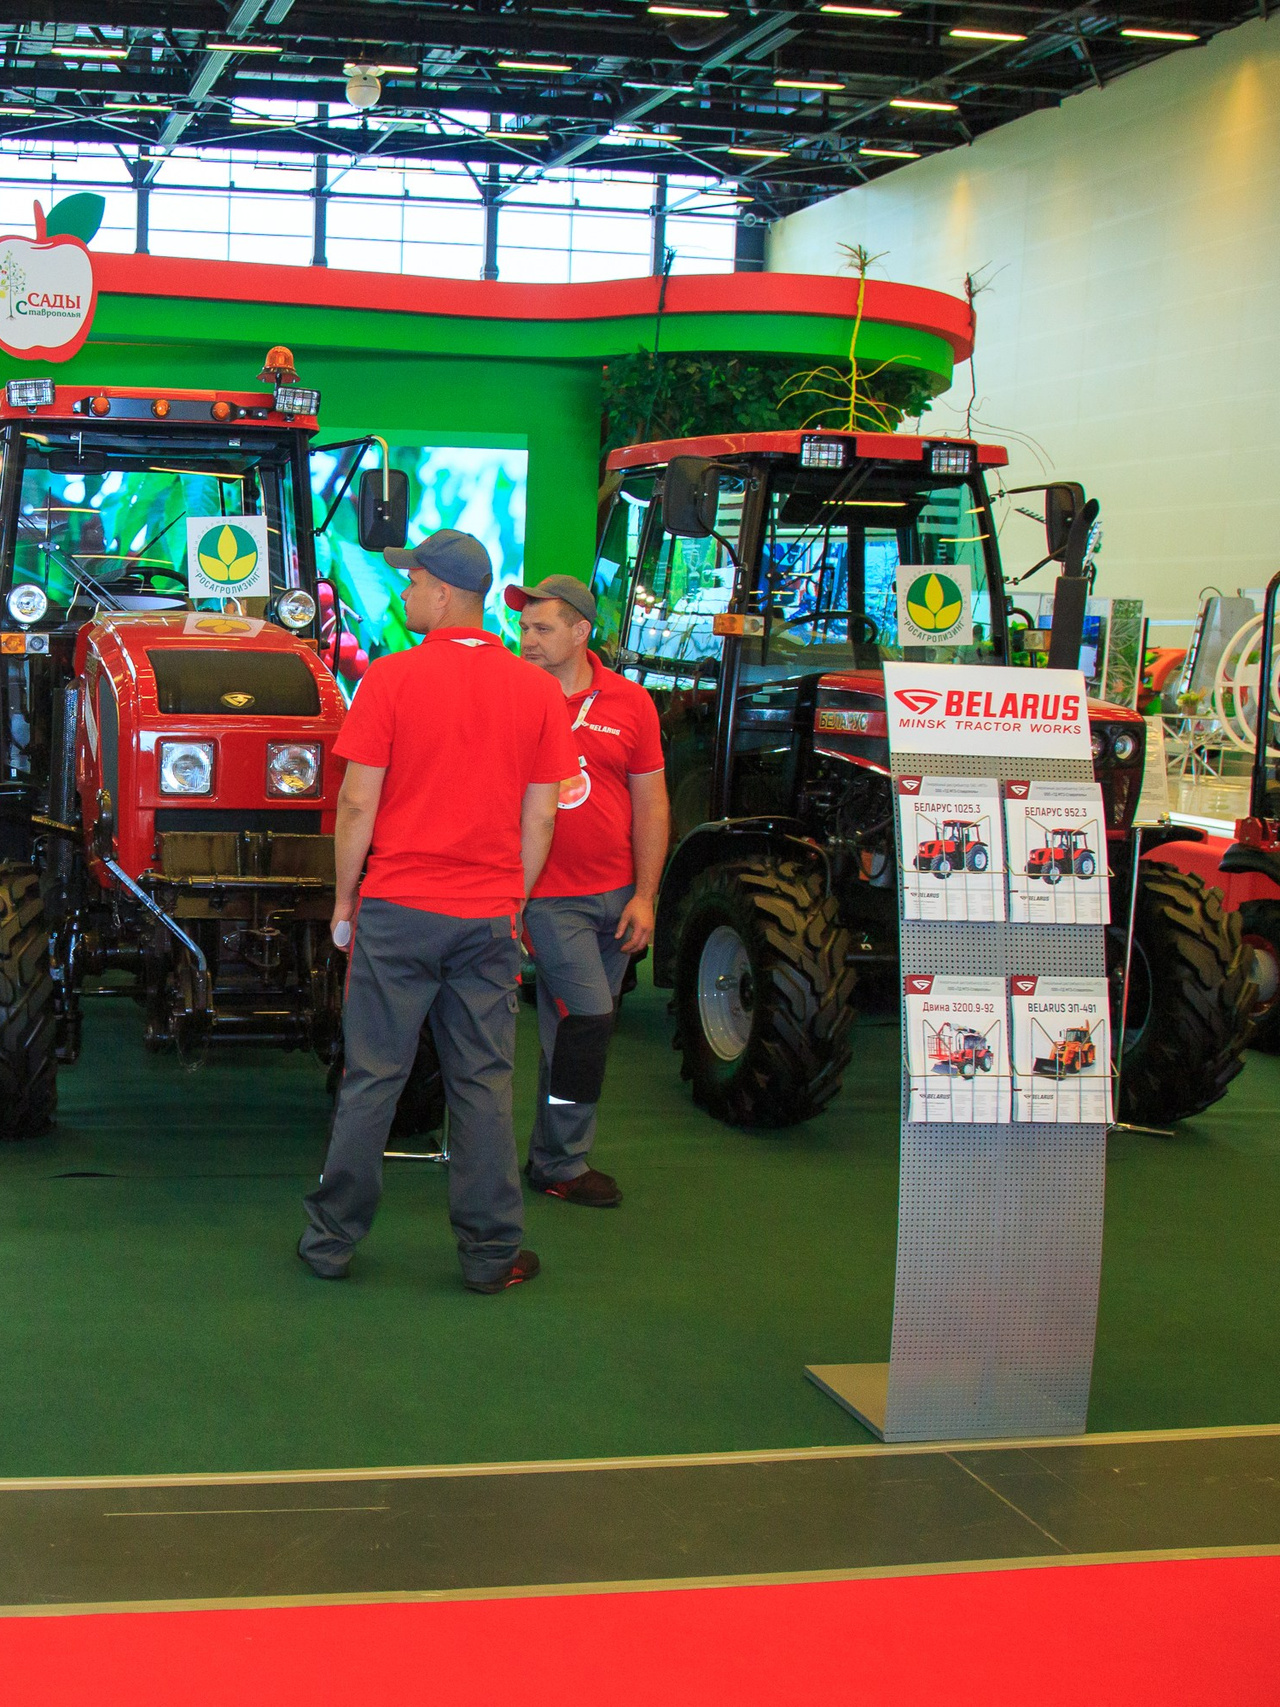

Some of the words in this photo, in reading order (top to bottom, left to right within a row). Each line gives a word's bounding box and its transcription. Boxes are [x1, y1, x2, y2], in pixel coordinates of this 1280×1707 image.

[15, 300, 81, 318] Ставрополья
[27, 293, 81, 309] САДЫ
[194, 568, 261, 595] "РОСАГРОЛИЗИНГ"
[903, 616, 966, 643] "РОСАГРОЛИЗИНГ"
[945, 690, 1080, 721] BELARUS
[589, 724, 621, 736] BELARUS
[820, 712, 868, 732] БЕЛАРУС
[899, 718, 947, 729] MINSK
[955, 721, 1021, 732] TRACTOR
[1030, 724, 1082, 734] WORKS
[914, 803, 952, 813] БЕЛАРУС
[954, 804, 981, 814] 1025.3
[1024, 807, 1062, 817] БЕЛАРУС
[1064, 808, 1087, 817] 952.3
[922, 1002, 950, 1013] Двина
[952, 1002, 994, 1013] 3200.9-92
[1027, 1003, 1066, 1013] BELARUS
[1068, 1003, 1097, 1013] ЭП-491
